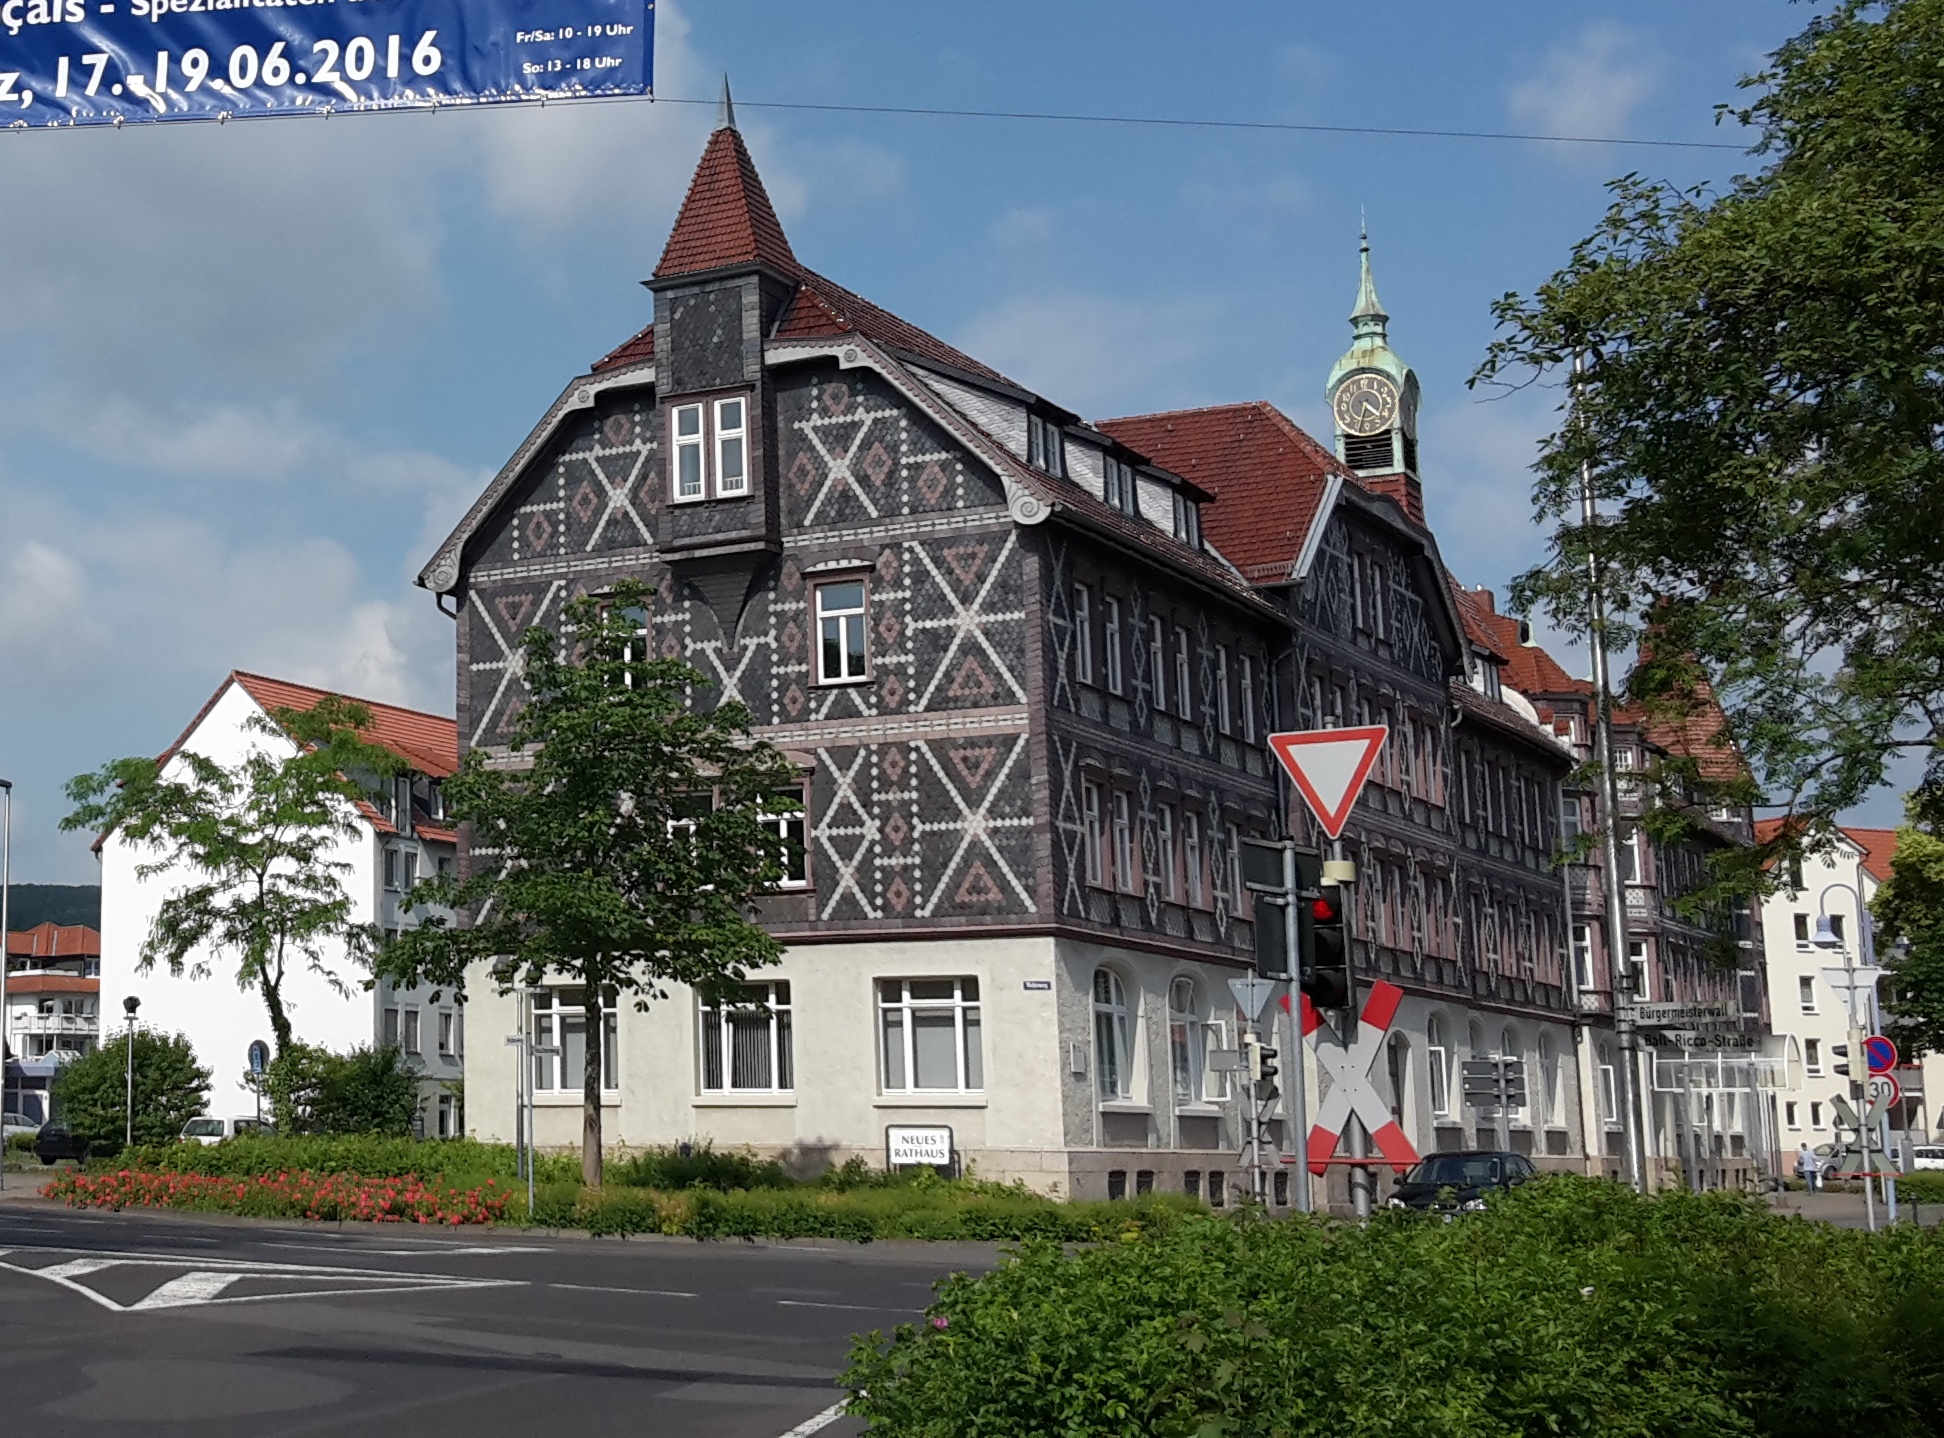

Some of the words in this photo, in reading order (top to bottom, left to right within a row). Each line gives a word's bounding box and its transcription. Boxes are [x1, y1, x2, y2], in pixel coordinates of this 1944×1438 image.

[516, 30, 555, 43] Fr/Sa:
[559, 27, 573, 39] 10
[587, 25, 602, 37] 19
[606, 24, 634, 36] Uhr
[522, 62, 544, 74] So:
[547, 60, 562, 72] 13
[576, 58, 591, 70] 18
[595, 57, 622, 68] Uhr
[1640, 1003, 1728, 1022] Bürgermeisterwall
[1869, 1082, 1891, 1098] 30
[901, 1135, 937, 1145] NEUES
[894, 1148, 945, 1159] RATHAUS
